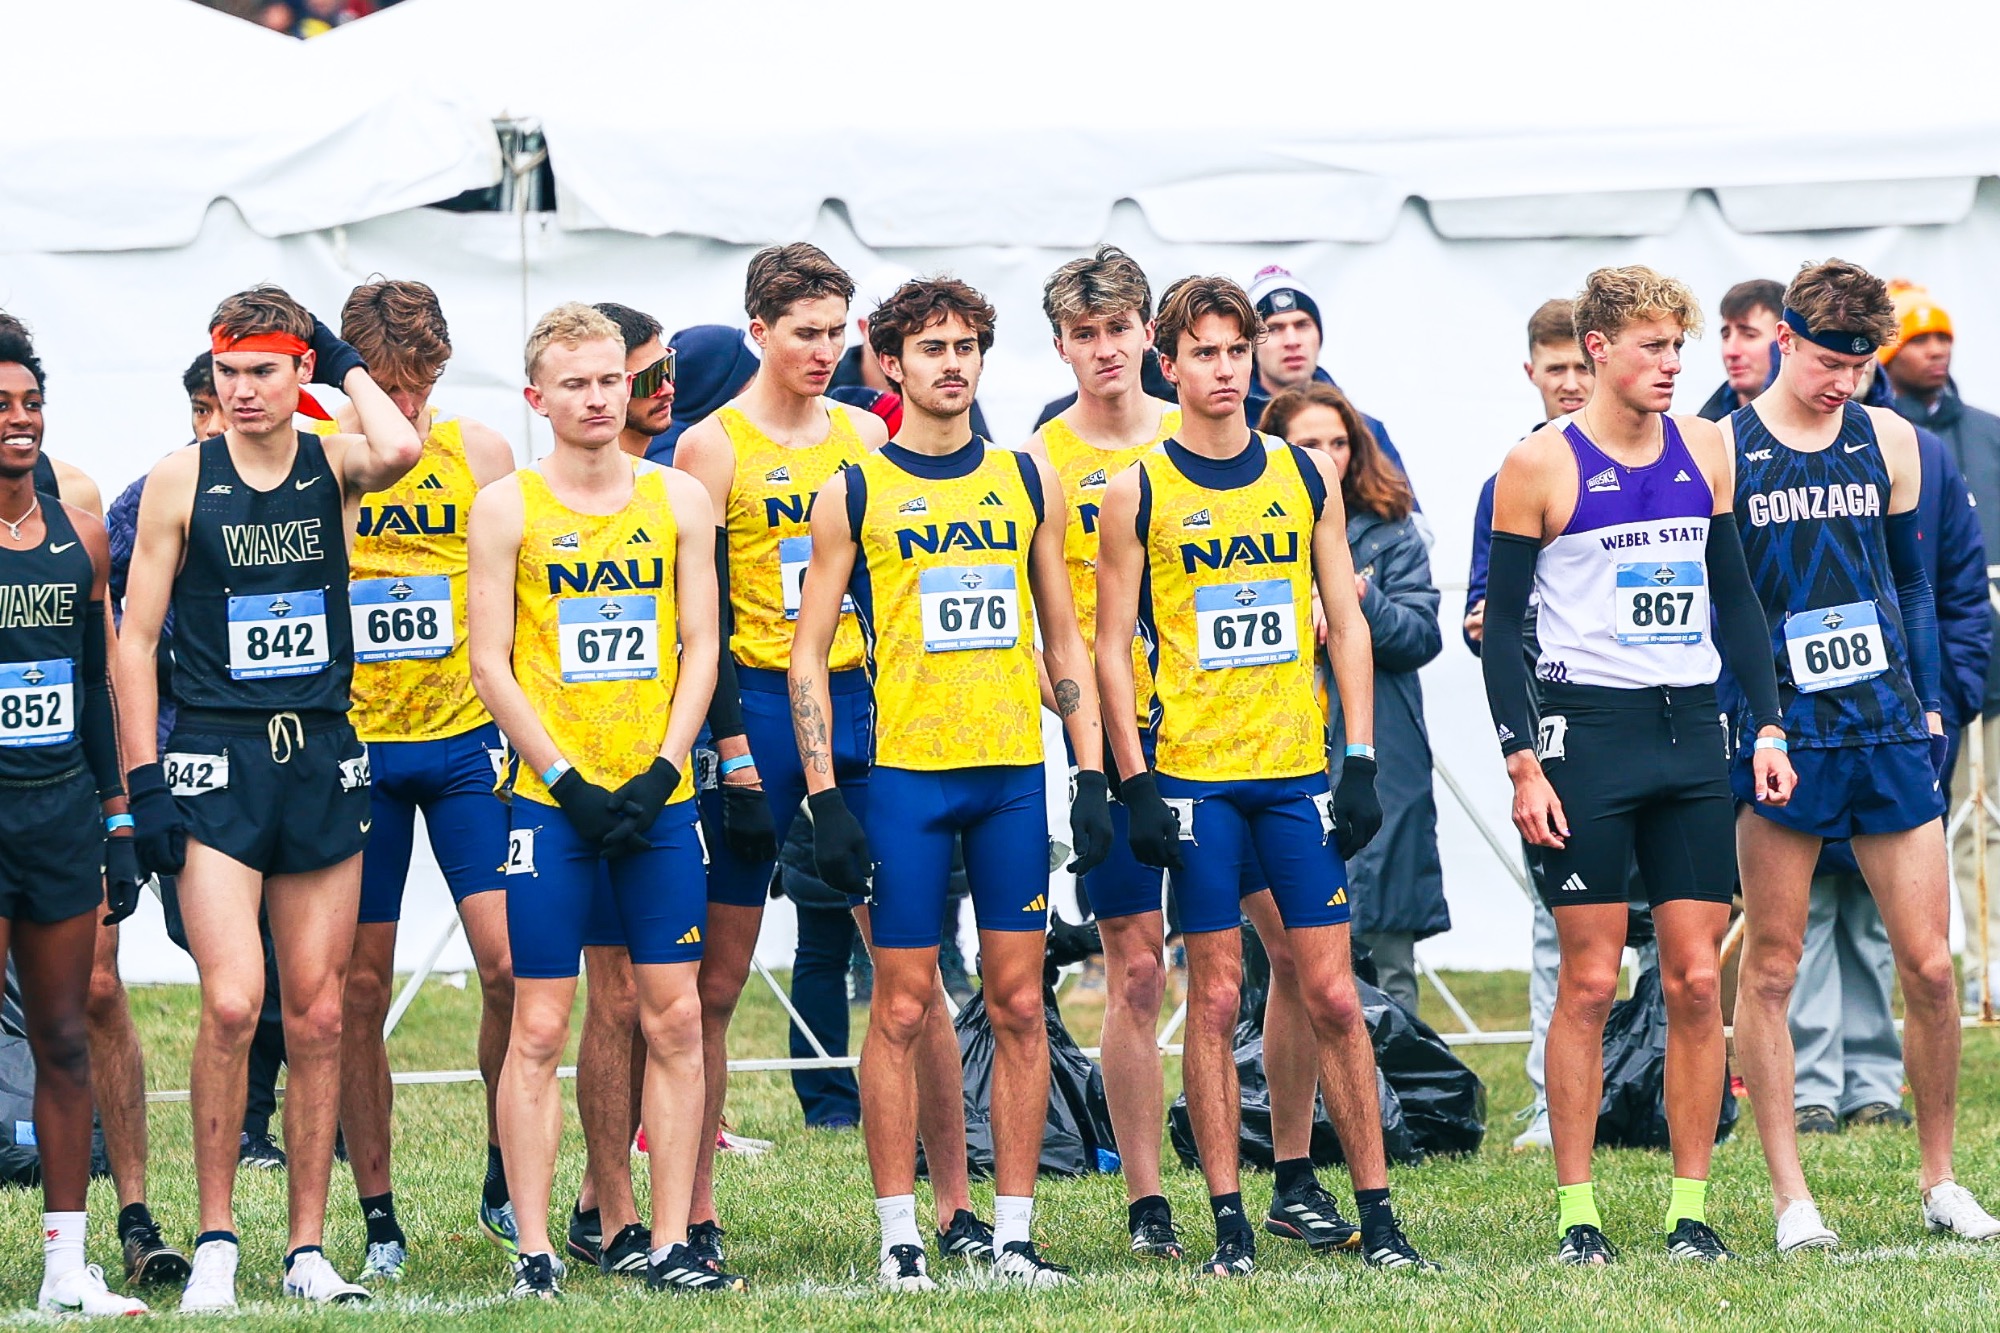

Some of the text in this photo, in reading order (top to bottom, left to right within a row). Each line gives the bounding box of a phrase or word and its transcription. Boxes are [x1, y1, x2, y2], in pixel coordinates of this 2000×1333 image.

[1745, 449, 1773, 462] WCC
[1748, 483, 1880, 527] GONZAGA
[222, 518, 324, 567] WAKE
[894, 520, 1018, 560] NAU
[1178, 531, 1298, 575] NAU
[1600, 531, 1651, 551] WEBER
[545, 557, 663, 595] NAU
[368, 606, 438, 643] 668
[940, 595, 1006, 632] 676
[1633, 592, 1694, 626] 867
[247, 622, 315, 661] 842
[577, 626, 645, 663] 672
[1213, 611, 1282, 650] 678
[1805, 632, 1872, 675] 608
[1, 691, 62, 729] 852
[167, 761, 213, 788] 842
